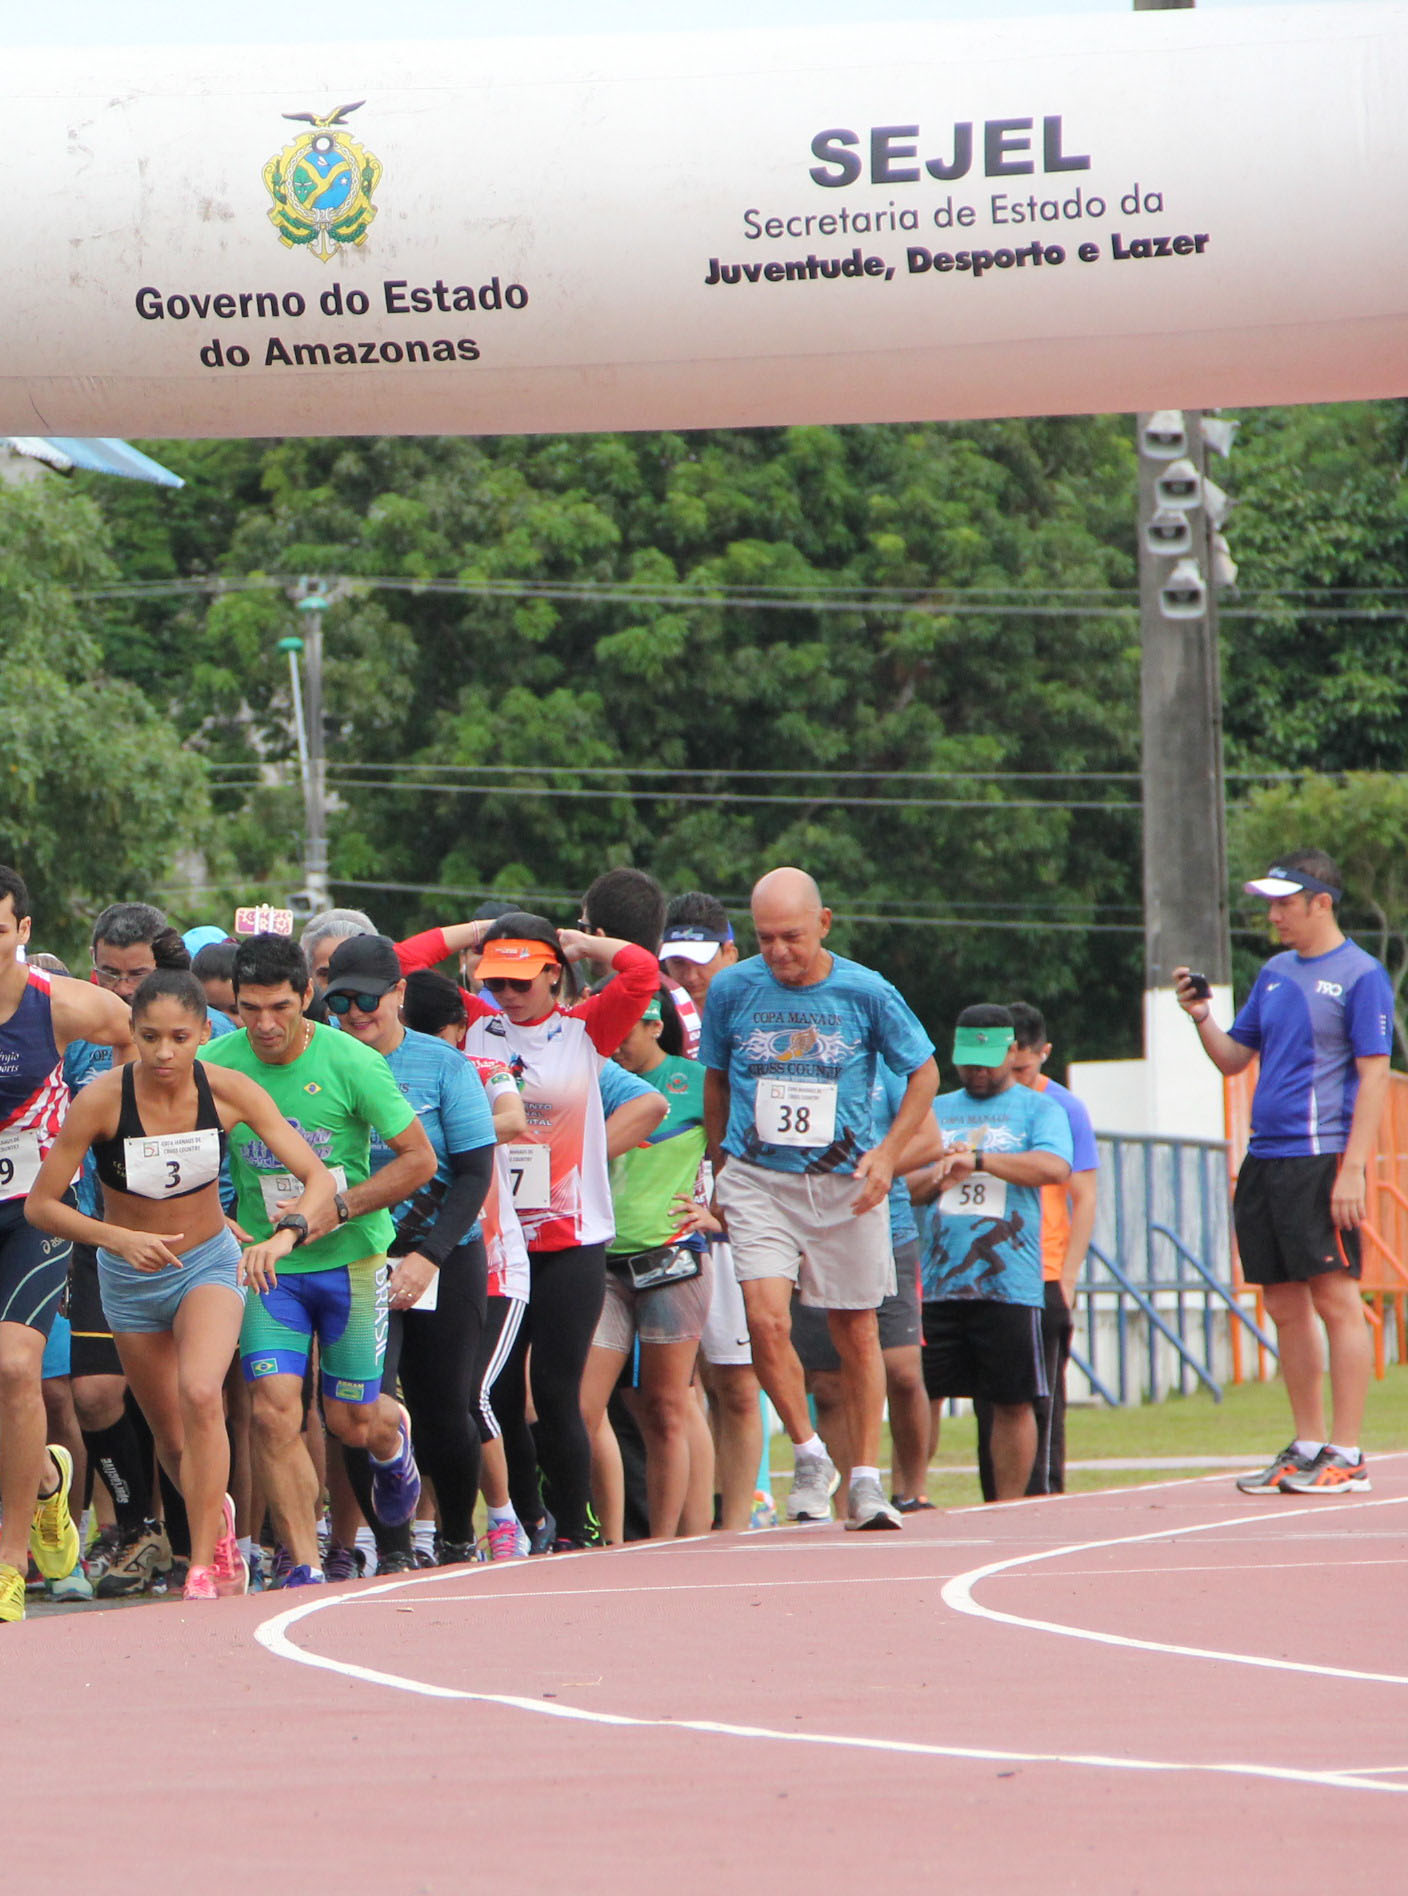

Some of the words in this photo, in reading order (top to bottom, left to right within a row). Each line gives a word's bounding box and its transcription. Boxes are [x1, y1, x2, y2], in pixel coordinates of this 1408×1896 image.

[808, 114, 1092, 188] SEJEL
[743, 200, 919, 240] Secretaria
[934, 196, 976, 228] de
[992, 187, 1106, 224] Estado
[1120, 182, 1163, 214] da
[704, 248, 896, 285] Juventude,
[907, 241, 1065, 277] Desporto
[1078, 241, 1100, 262] e
[1111, 232, 1209, 261] Lazer
[135, 286, 306, 320] Governo
[320, 282, 370, 316] do
[384, 276, 529, 314] Estado
[199, 338, 250, 368] do
[265, 336, 481, 366] Amazonas
[753, 1011, 784, 1024] COPA
[788, 1011, 842, 1026] MANAUS
[777, 1105, 810, 1133] 38
[164, 1161, 181, 1188] 3
[959, 1183, 986, 1206] 58
